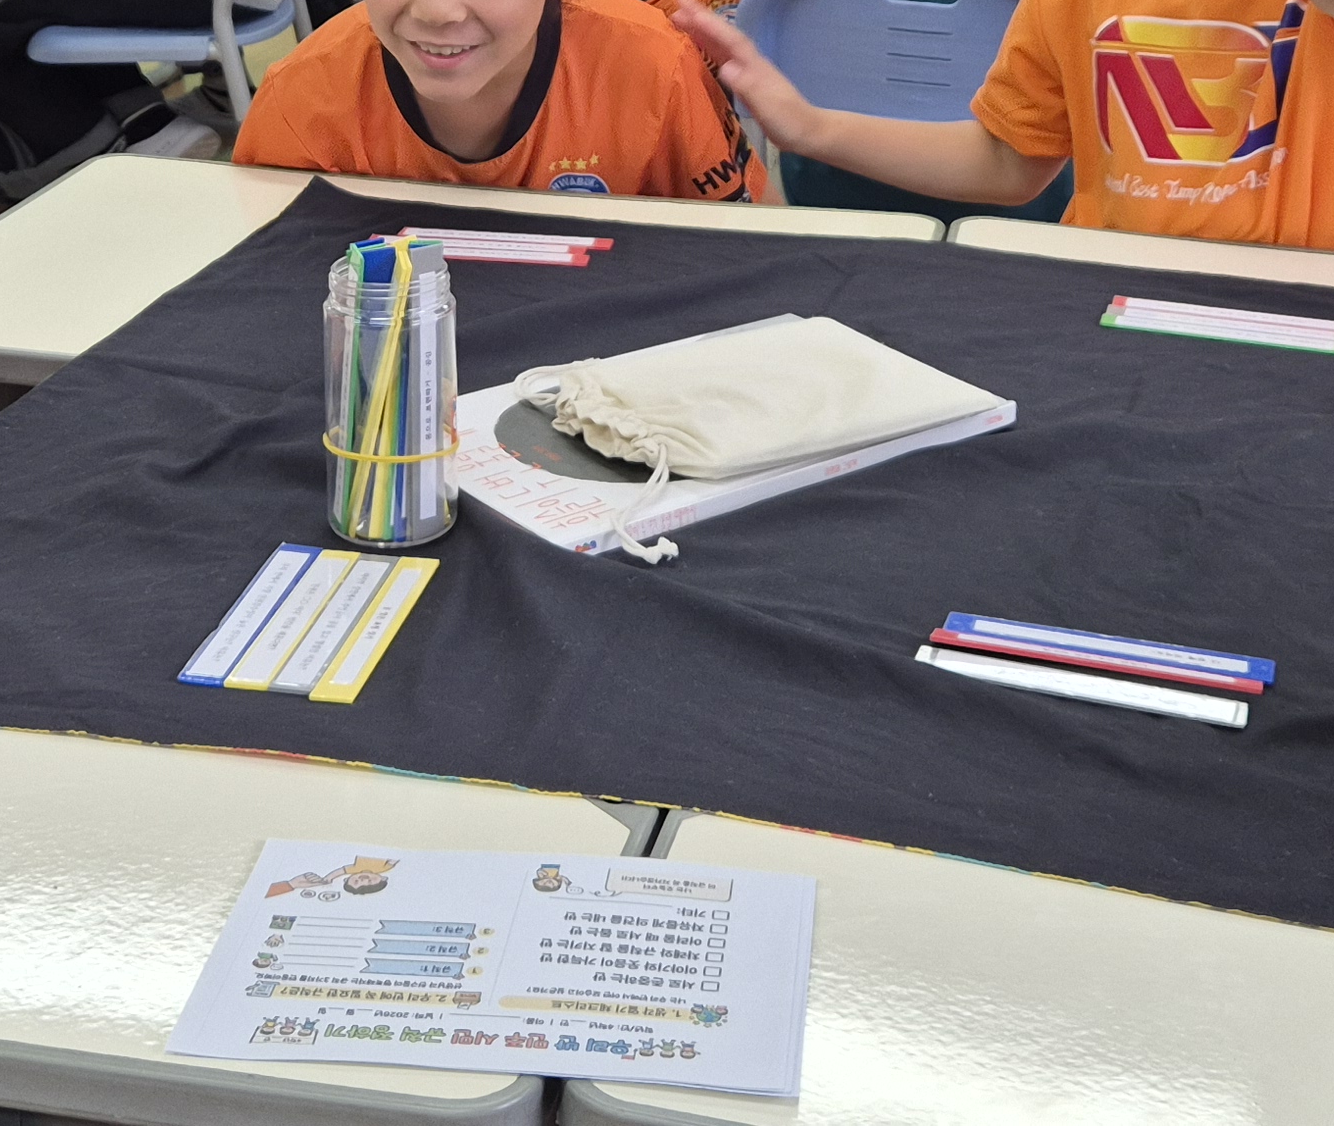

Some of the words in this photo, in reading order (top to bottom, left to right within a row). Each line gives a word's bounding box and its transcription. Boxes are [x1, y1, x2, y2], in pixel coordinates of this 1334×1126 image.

[564, 911, 577, 923] 반
[676, 907, 706, 918] 기타:
[580, 912, 606, 926] 내는
[610, 914, 649, 929] 의견을
[443, 925, 464, 934] 규칙
[569, 925, 583, 936] 반
[653, 918, 704, 933] 자유롭게
[586, 926, 611, 938] 돕는
[617, 930, 642, 941] 서로
[645, 932, 659, 943] 때
[539, 938, 553, 950] 반
[557, 939, 596, 952] 지키는
[663, 934, 702, 947] 어려울
[436, 945, 457, 953] 규칙
[599, 942, 612, 954] 잘
[617, 943, 656, 958] 규칙을
[539, 952, 553, 964] 반
[660, 948, 699, 961] 차례와
[557, 954, 597, 968] 가득한
[600, 957, 640, 972] 웃음이
[431, 965, 452, 973] 규칙
[644, 962, 698, 976] 이야기와
[593, 972, 607, 982] 반
[610, 974, 664, 988] 존중하는
[668, 979, 695, 990] 서로
[279, 985, 324, 997] 규칙은?
[327, 987, 362, 999] 필요한
[365, 990, 376, 1000] 꼭
[380, 991, 404, 1001] 반에
[407, 992, 432, 1001] 우리
[436, 994, 447, 1002] 2.
[551, 1000, 611, 1013] 체크리스트
[615, 1004, 639, 1016] 열기
[643, 1006, 666, 1018] 생각
[671, 1010, 682, 1018] 1.
[324, 1023, 395, 1041] 정하기
[399, 1027, 446, 1043] 규칙
[450, 1029, 499, 1046] 시민
[504, 1032, 550, 1050] 민주
[555, 1035, 580, 1052] 반
[585, 1038, 633, 1054] 우리
